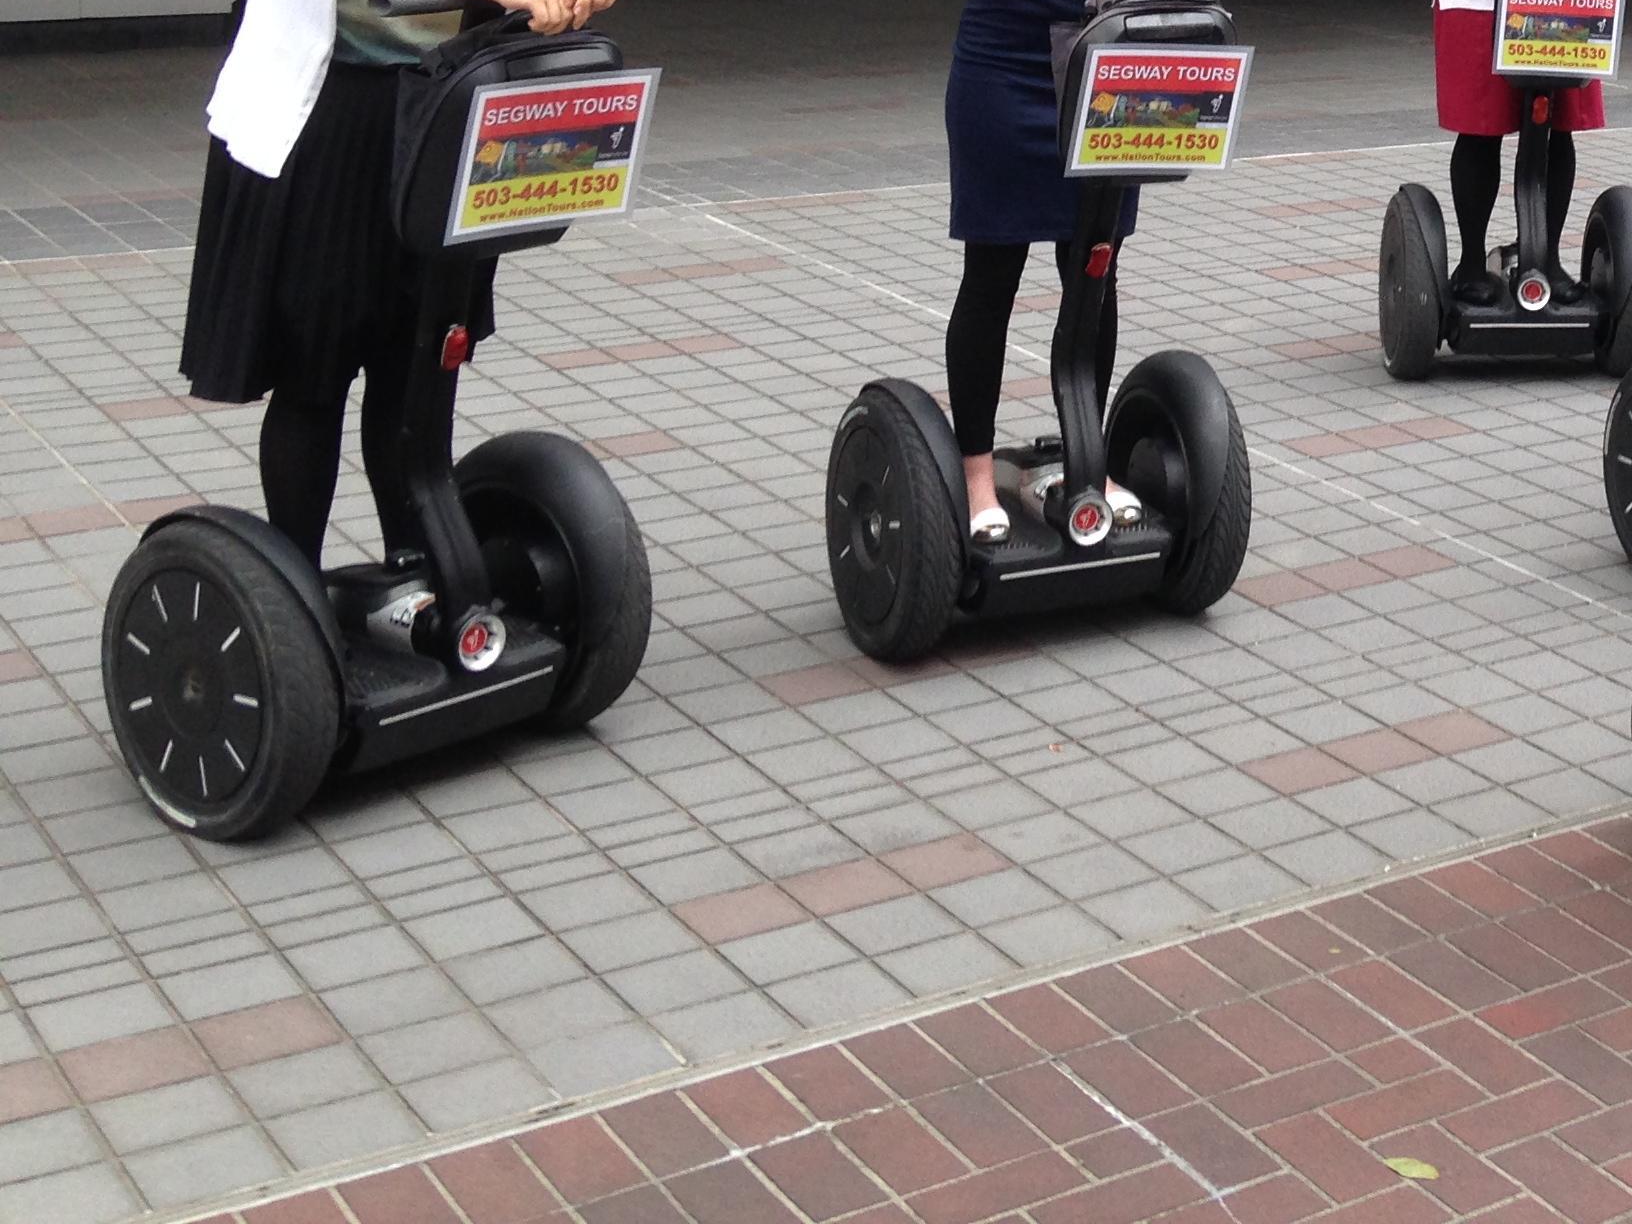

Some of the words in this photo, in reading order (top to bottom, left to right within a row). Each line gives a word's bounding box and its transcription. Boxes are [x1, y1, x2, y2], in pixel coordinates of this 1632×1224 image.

[1508, 43, 1606, 60] 503-444-1530
[1097, 65, 1173, 80] SEGWAY
[1177, 66, 1236, 82] TOURS
[484, 100, 568, 127] SEGWAY
[573, 94, 639, 116] TOURS
[1088, 132, 1220, 150] 503-444-1530
[472, 173, 620, 210] 503-444-1530
